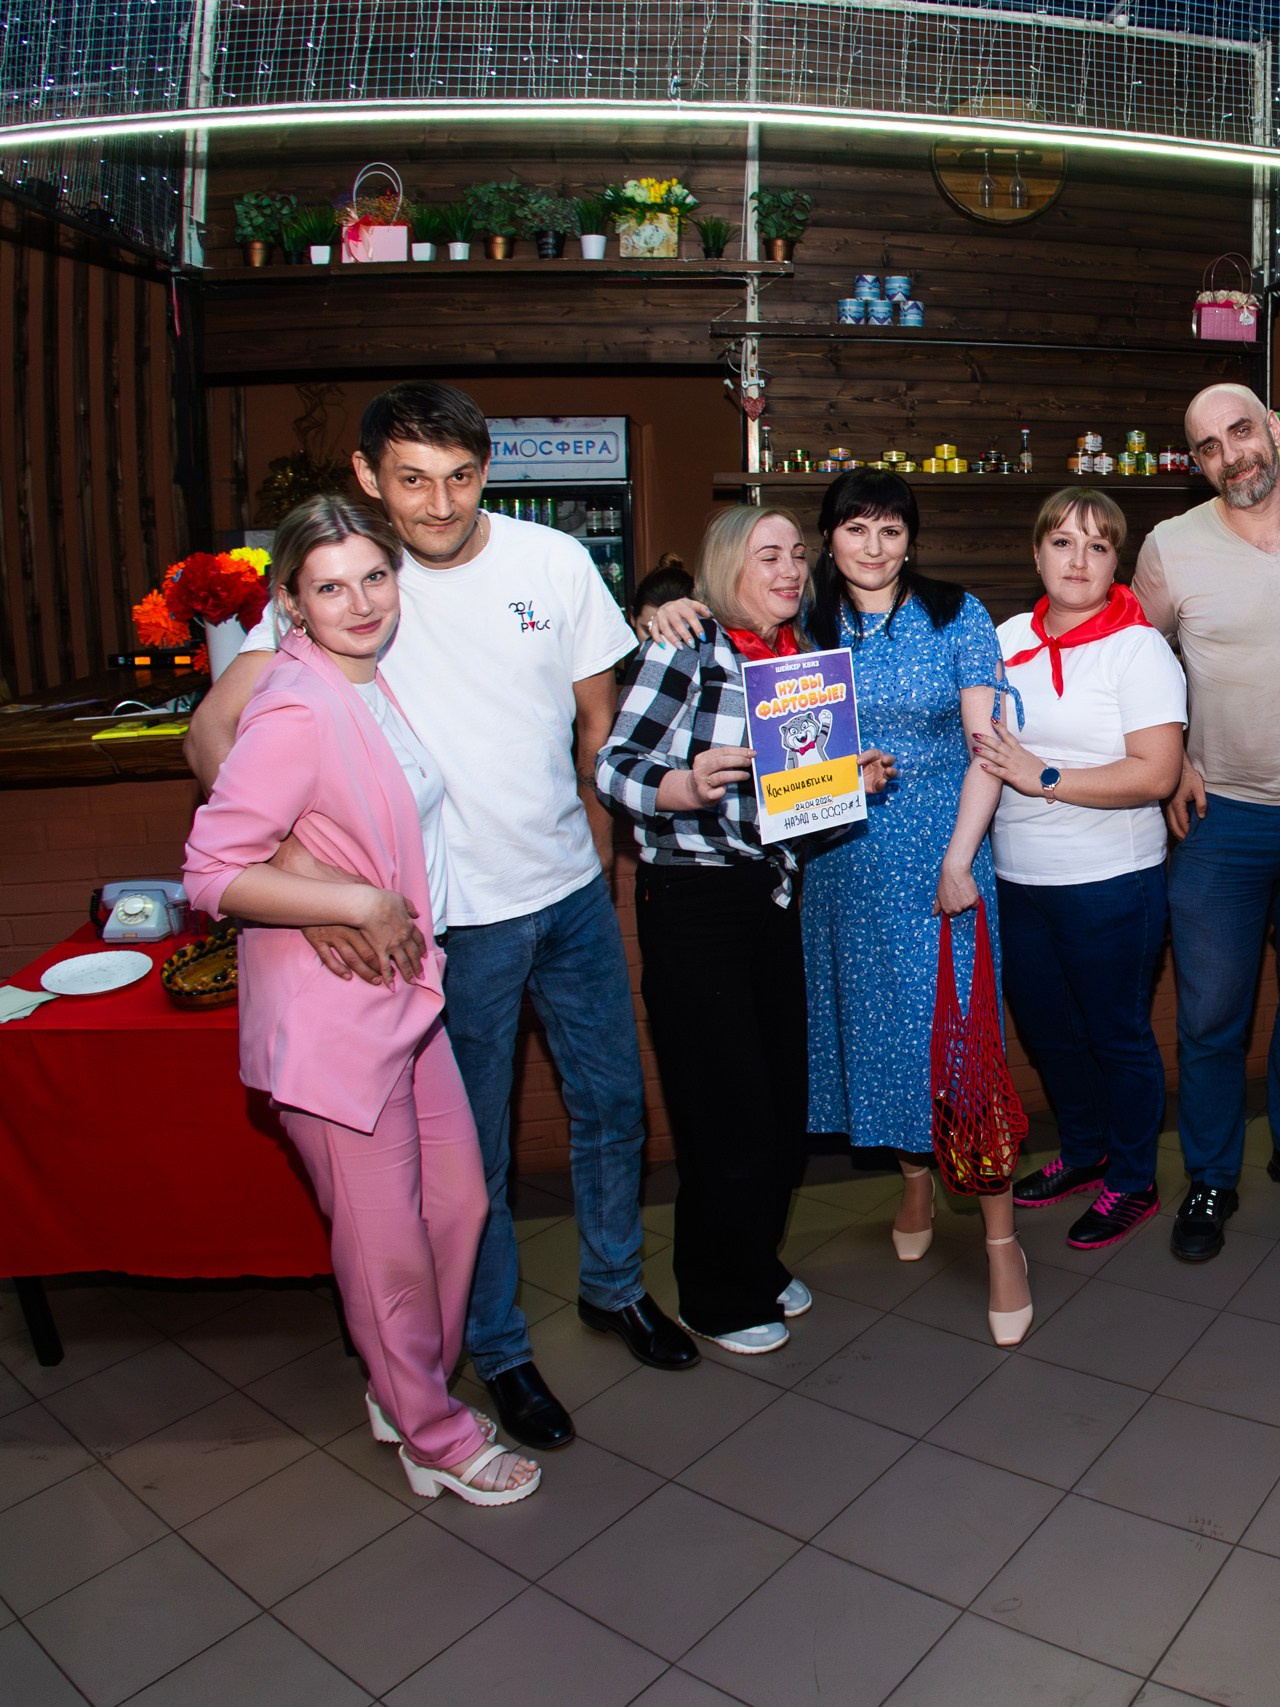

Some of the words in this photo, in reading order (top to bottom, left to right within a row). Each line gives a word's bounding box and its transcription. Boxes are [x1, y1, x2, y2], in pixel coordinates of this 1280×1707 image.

[492, 438, 612, 457] ТМОСФЕРА
[777, 680, 797, 697] НУ
[800, 674, 823, 692] ВЫ
[757, 685, 845, 718] ФАРТОВЫЕ!
